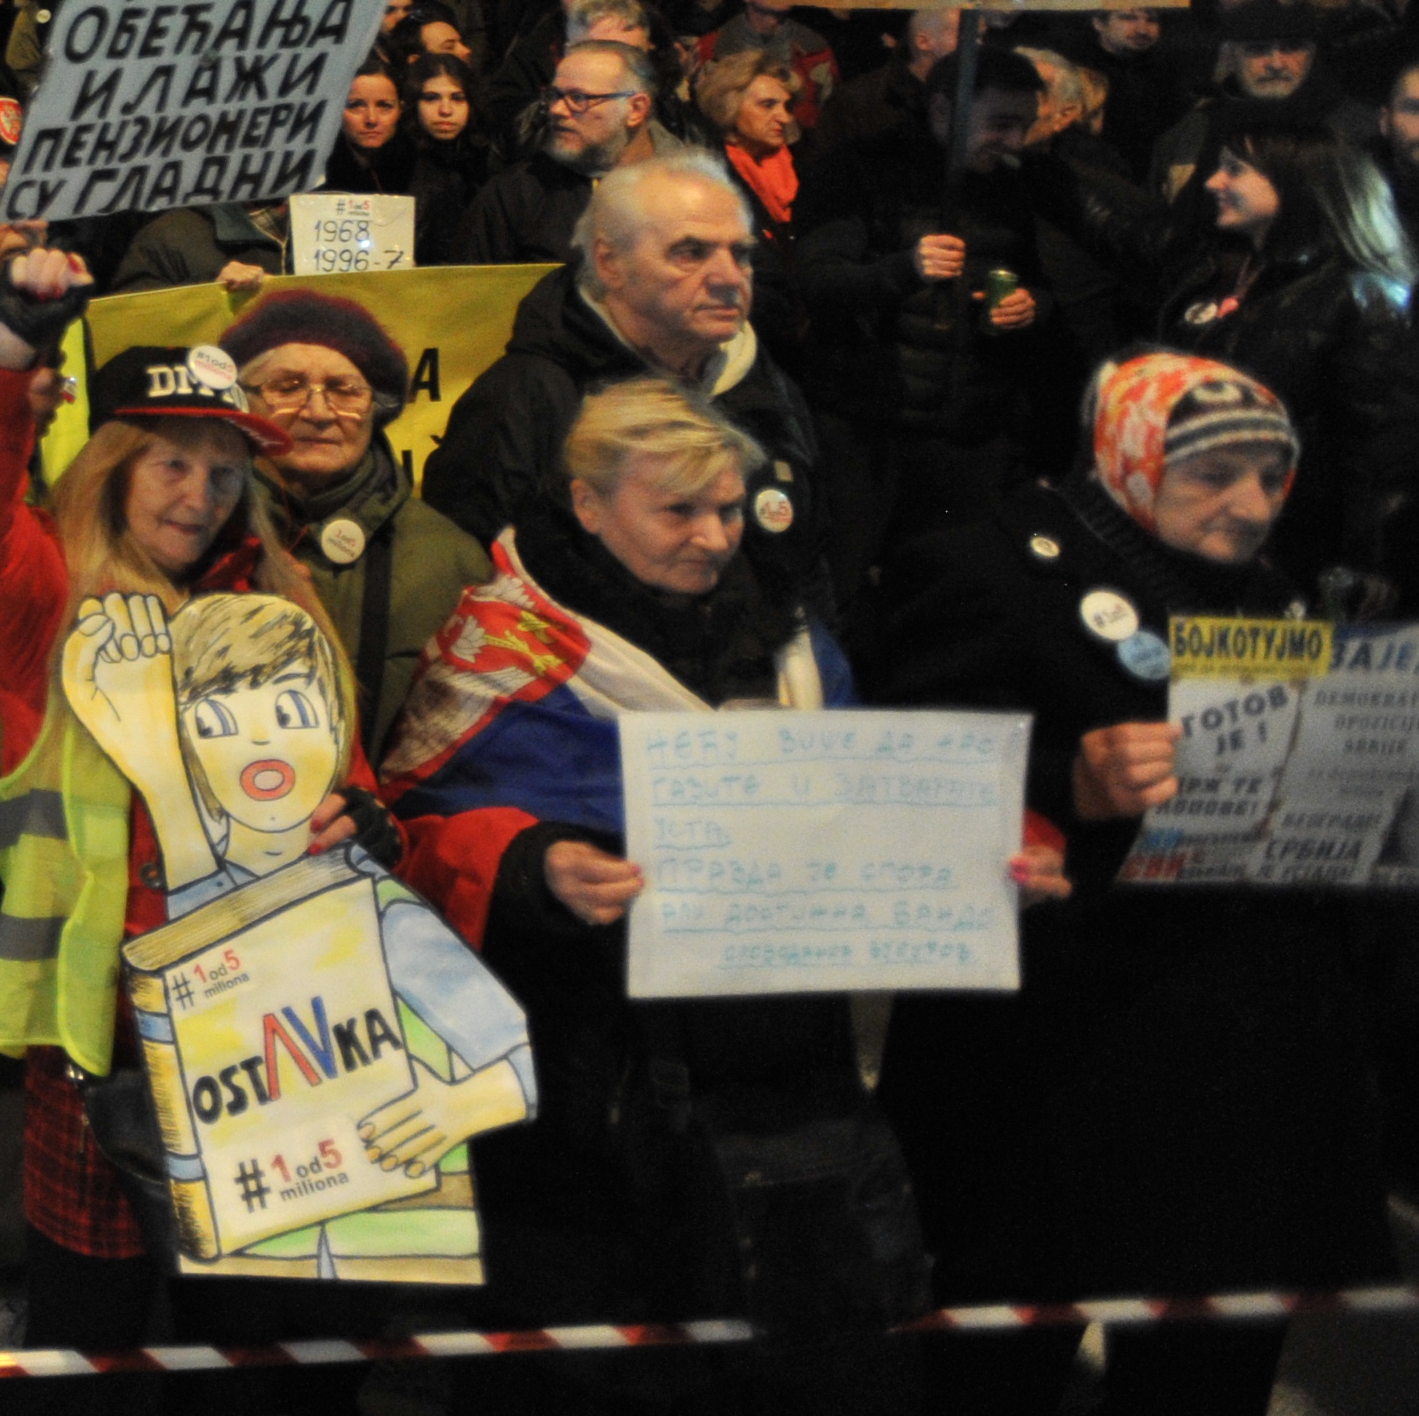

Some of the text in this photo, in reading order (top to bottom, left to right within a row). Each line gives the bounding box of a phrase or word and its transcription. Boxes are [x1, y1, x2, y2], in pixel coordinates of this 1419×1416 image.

[69, 51, 332, 122] И ЛАЖИ
[20, 98, 329, 177] ПЕНЗИОНЕРИ
[73, 147, 319, 216] ГЛАДНИ
[314, 220, 371, 243] 1968
[204, 972, 251, 1000] miliona
[279, 1170, 351, 1204] miliona
